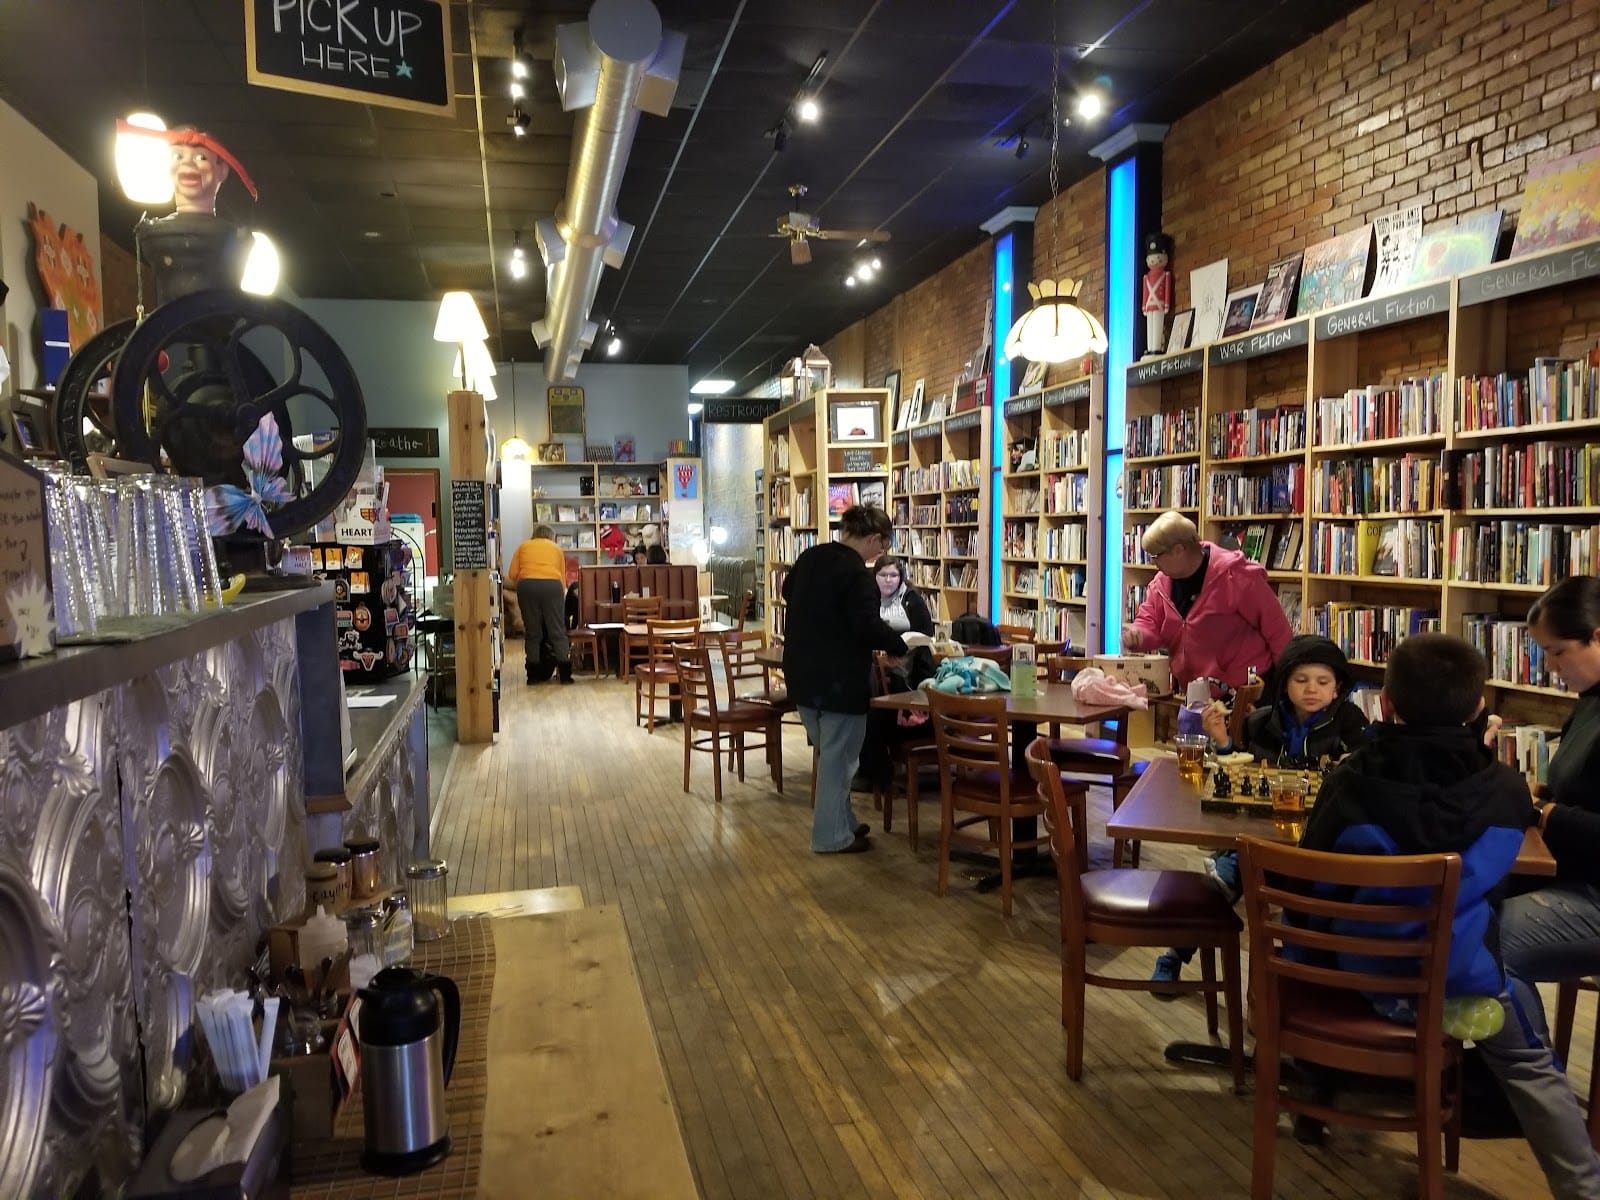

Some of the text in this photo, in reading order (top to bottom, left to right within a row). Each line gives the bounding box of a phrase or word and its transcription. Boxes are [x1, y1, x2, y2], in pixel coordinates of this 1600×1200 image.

[301, 41, 390, 79] HERE
[1570, 248, 1600, 278] FIC
[341, 528, 373, 537] HEART
